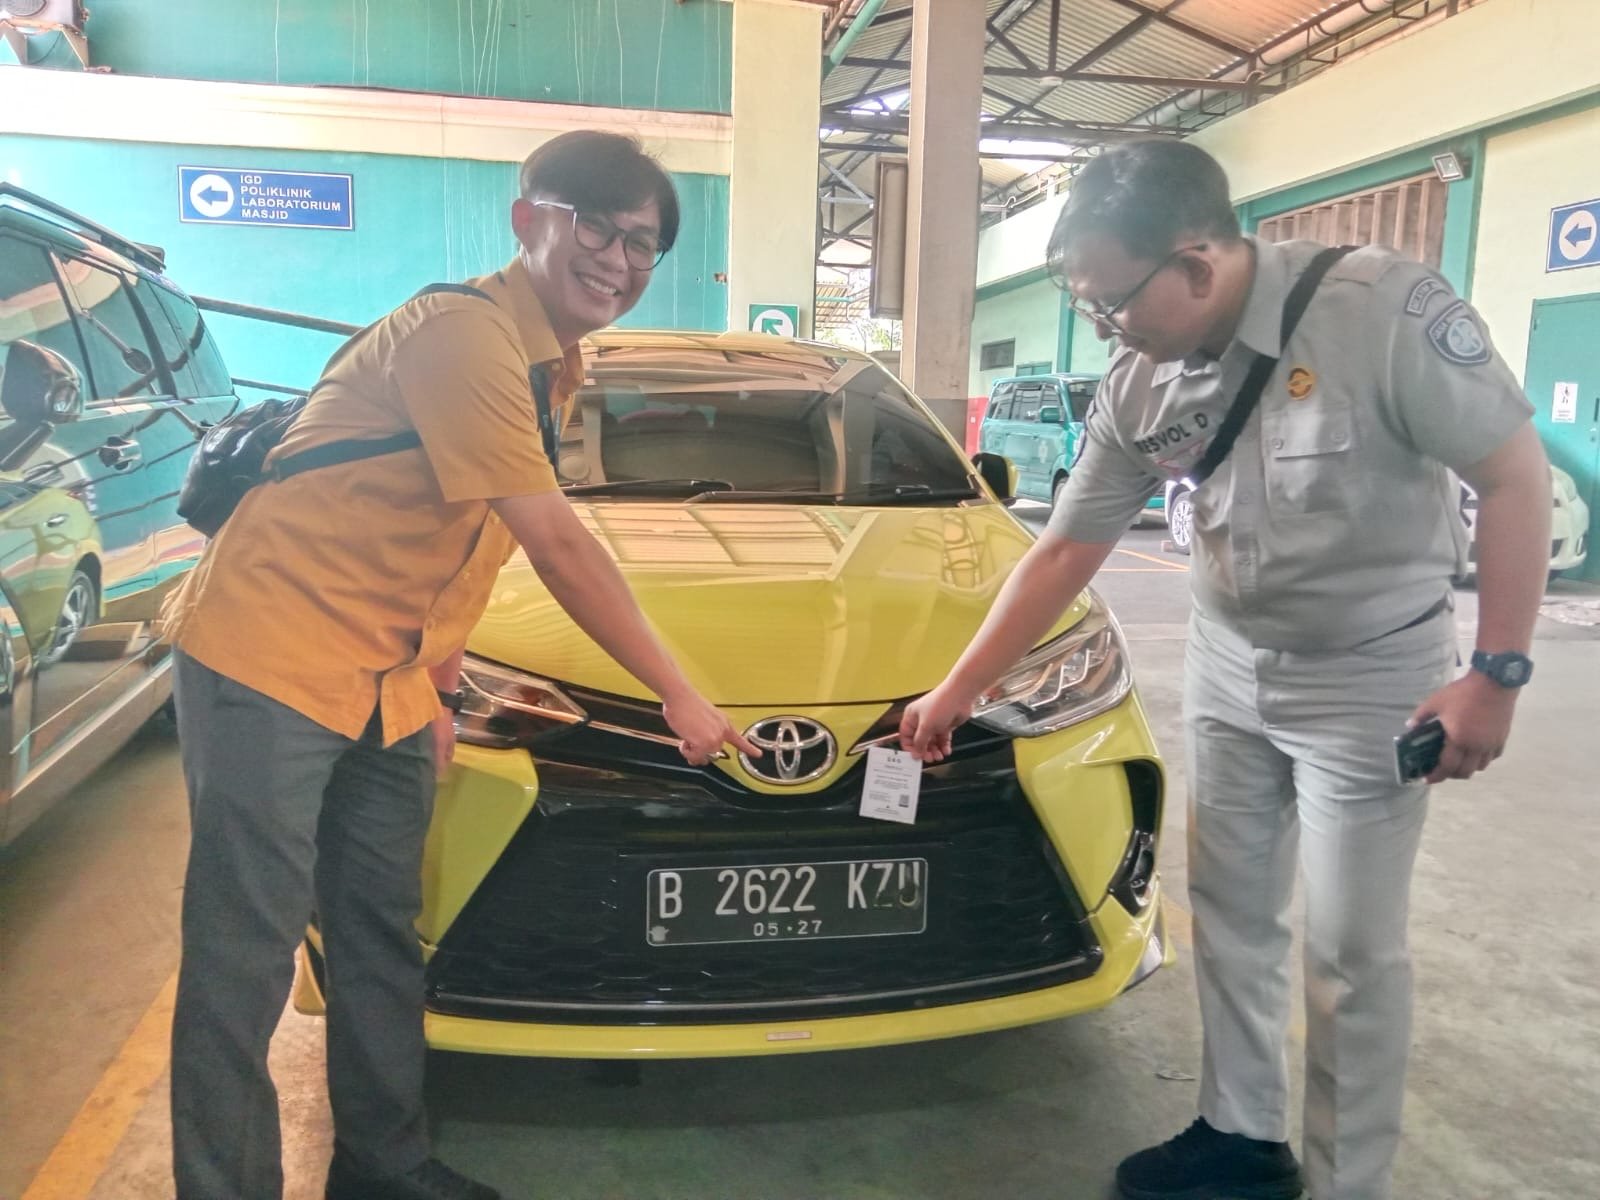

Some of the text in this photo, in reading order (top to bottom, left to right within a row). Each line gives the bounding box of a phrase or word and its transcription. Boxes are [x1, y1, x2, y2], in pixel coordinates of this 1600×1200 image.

[240, 175, 262, 184] IGD
[240, 186, 312, 198] POLIKLINIK
[241, 198, 341, 211] LABORATORIUM
[241, 209, 288, 220] MASJID
[1194, 412, 1208, 429] D
[659, 861, 920, 918] B 2622 KZU
